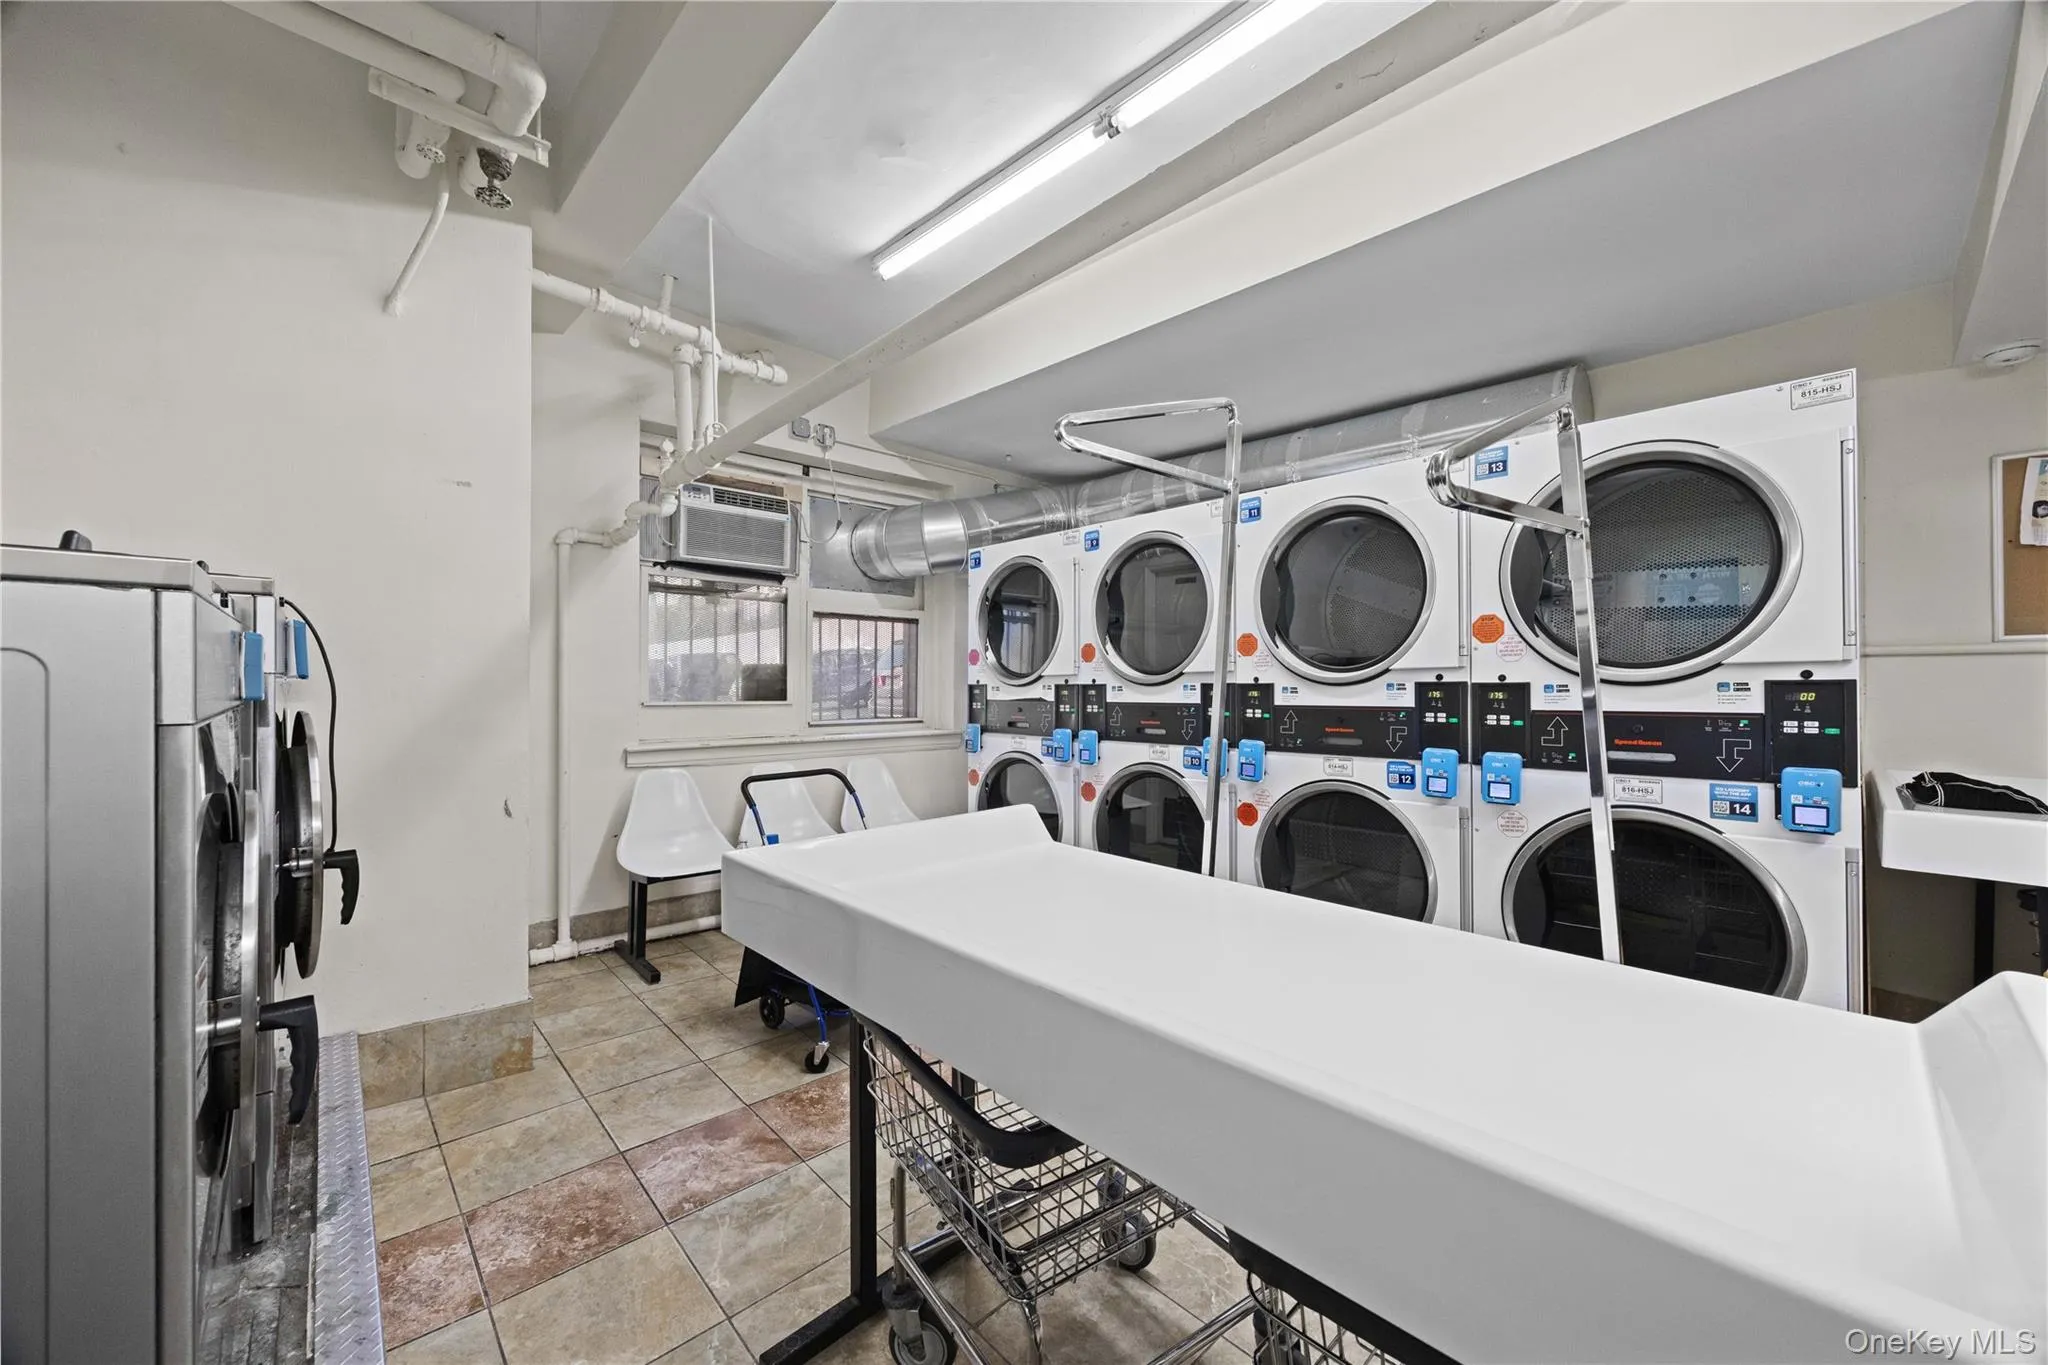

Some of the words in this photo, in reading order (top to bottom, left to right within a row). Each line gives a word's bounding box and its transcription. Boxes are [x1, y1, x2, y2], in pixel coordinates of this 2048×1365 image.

[1801, 384, 1842, 398] 815-HSJ
[1491, 462, 1504, 472] 13
[1614, 739, 1638, 747] Speed
[1401, 775, 1411, 784] 12
[1622, 786, 1654, 795] 816-HSJ
[1733, 803, 1751, 815] 14
